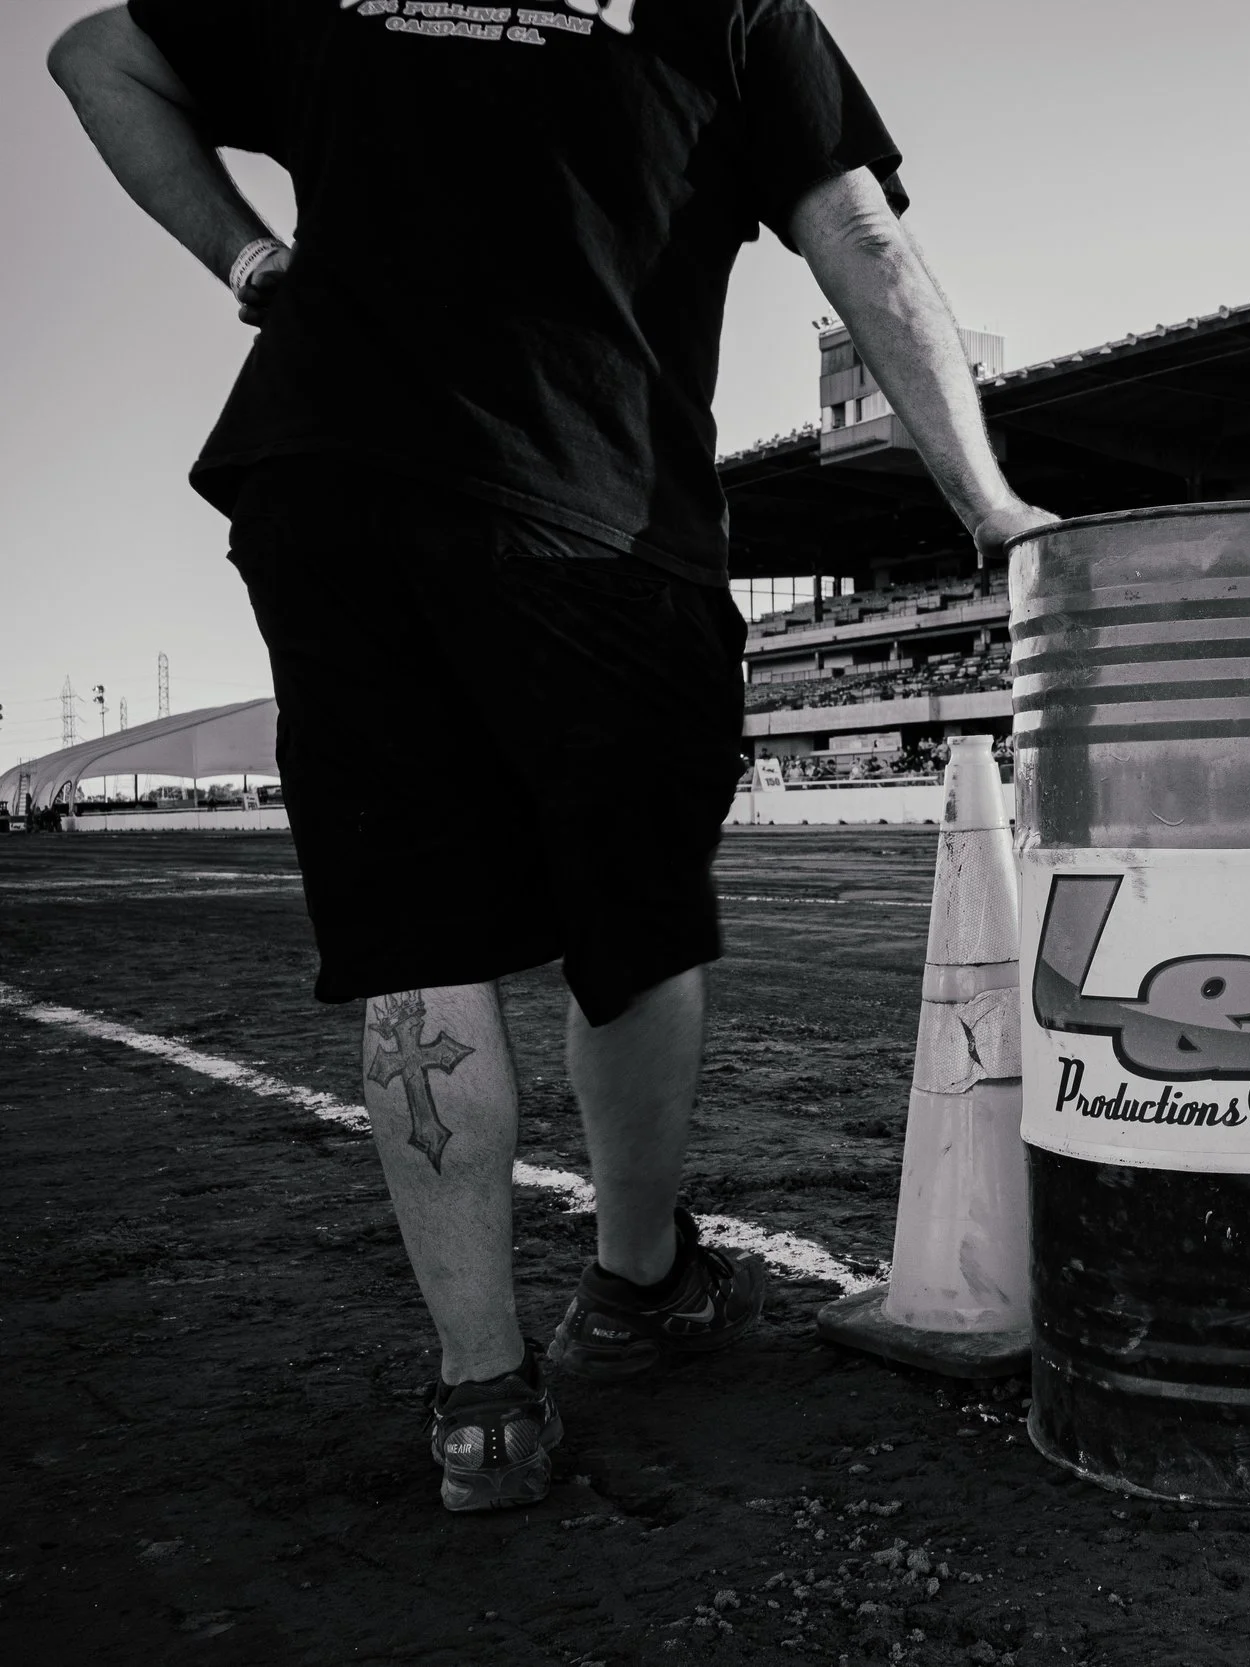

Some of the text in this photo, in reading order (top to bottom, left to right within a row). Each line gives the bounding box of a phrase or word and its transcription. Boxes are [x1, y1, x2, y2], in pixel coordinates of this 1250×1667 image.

[385, 16, 504, 40] OAKDALE
[403, 1, 511, 23] PULLING
[517, 8, 594, 35] TEAM
[1055, 1056, 1248, 1127] Productions
[458, 1443, 472, 1454] AIR
